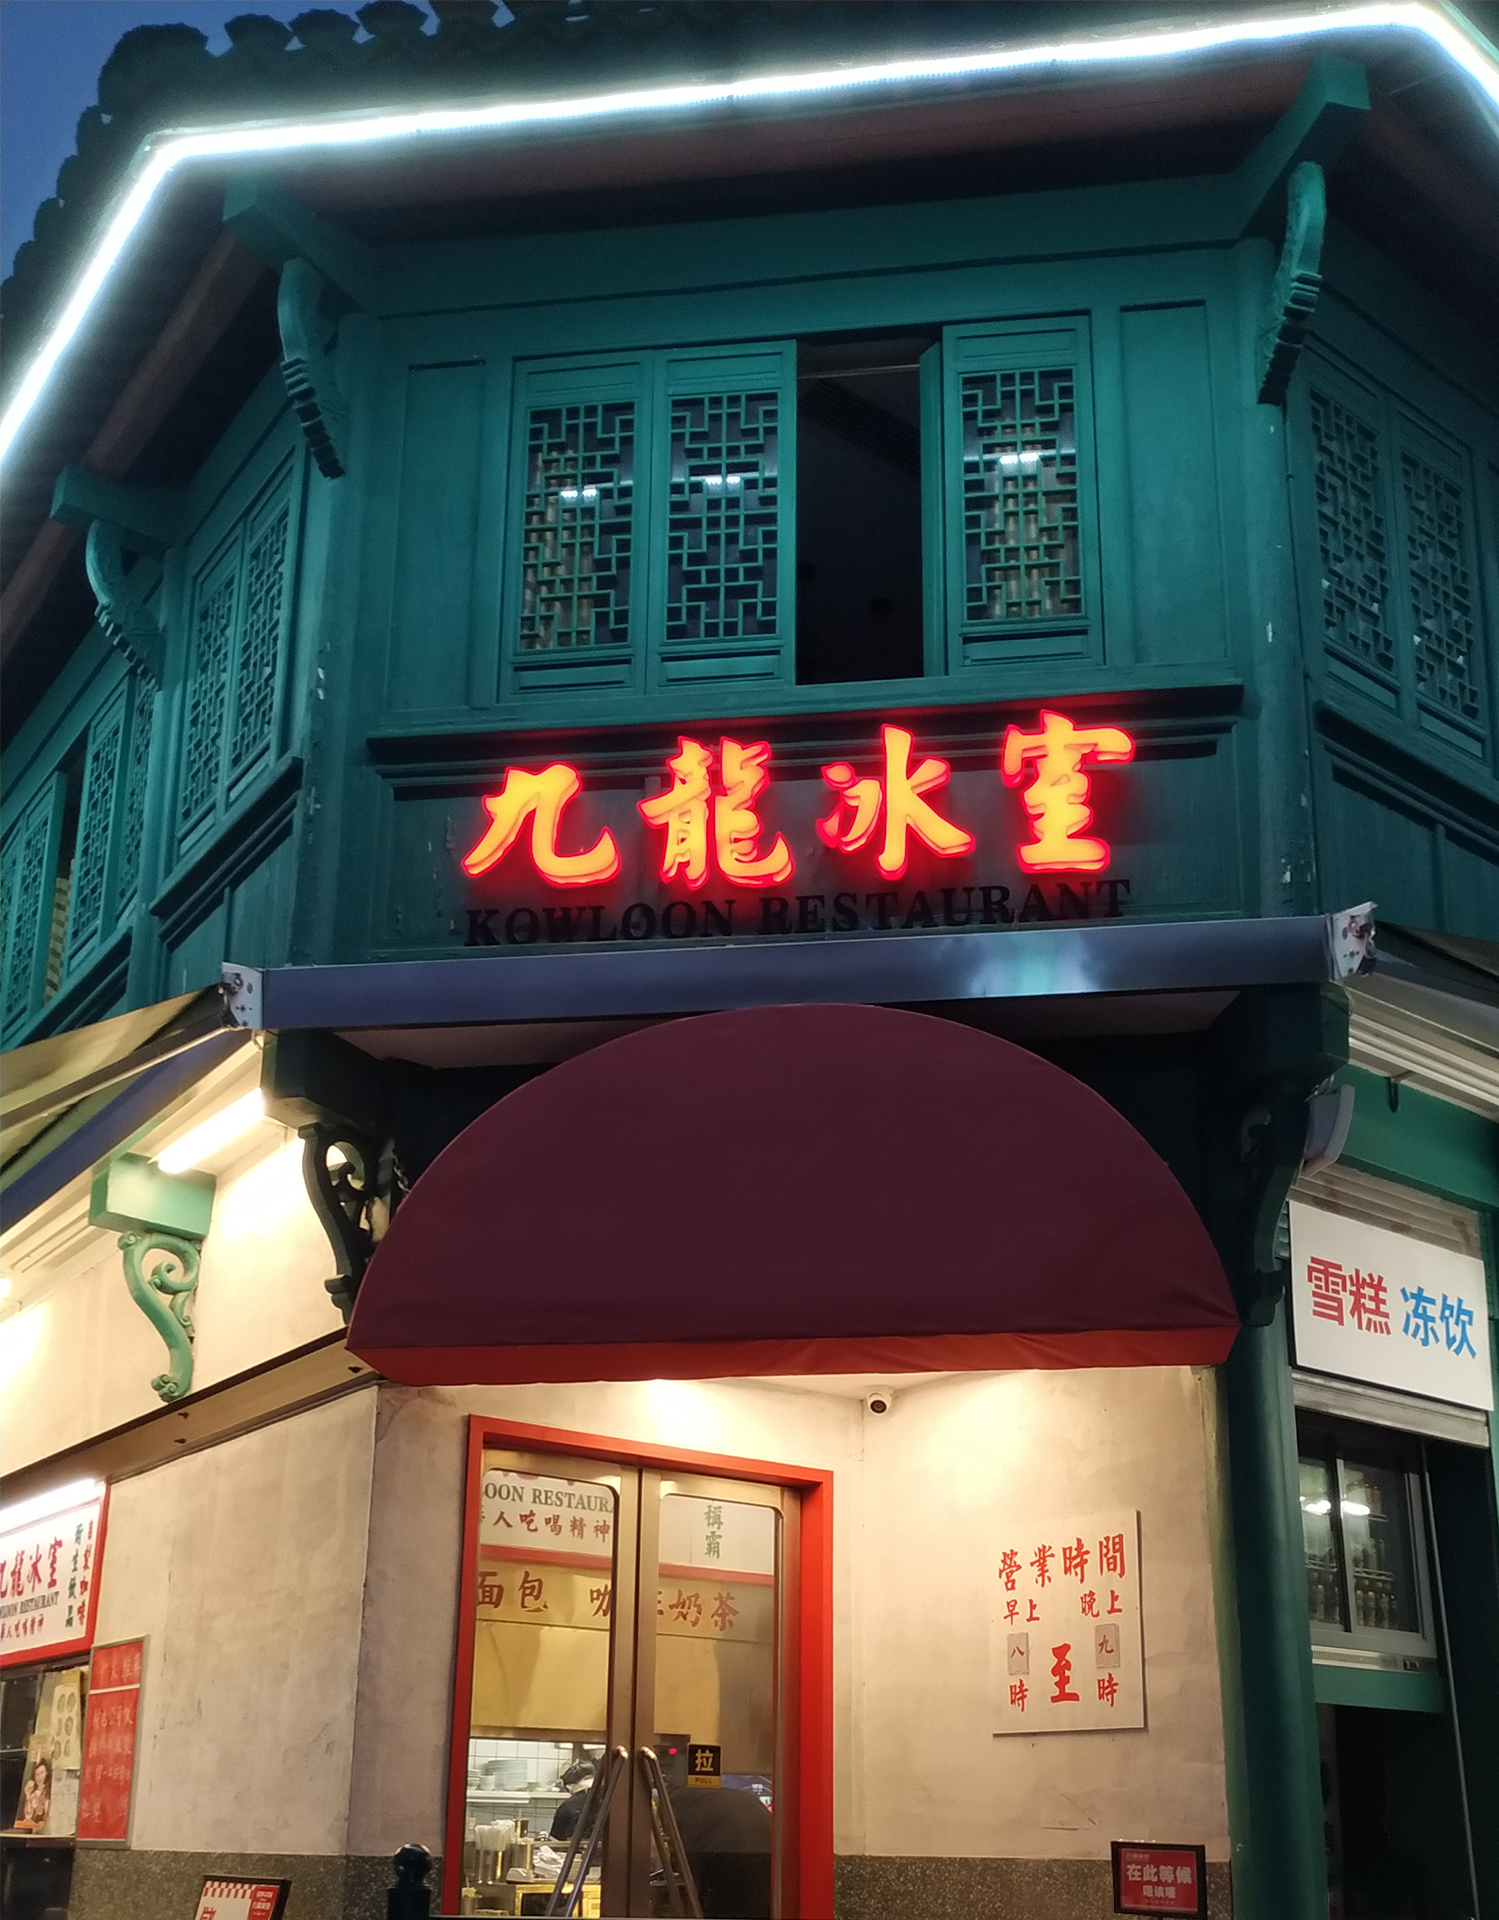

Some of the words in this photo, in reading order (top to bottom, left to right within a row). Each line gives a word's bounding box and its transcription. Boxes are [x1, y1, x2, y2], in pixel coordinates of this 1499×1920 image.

[462, 708, 1135, 890] 九龍冰室
[464, 899, 737, 947] KOWLOON
[758, 879, 1131, 936] RESTAURANT
[1306, 1255, 1391, 1336] 雪糕
[1400, 1285, 1477, 1359] 冻饮
[482, 1481, 525, 1502] OON
[703, 1504, 722, 1560] 稱霸
[998, 1532, 1127, 1592] 營業時間
[476, 1570, 548, 1614] 面包
[1003, 1598, 1040, 1626] 早上
[1080, 1589, 1123, 1618] 晚上
[1010, 1645, 1026, 1659] 八
[1098, 1634, 1115, 1655] 九
[1050, 1643, 1080, 1704] 至
[1097, 1672, 1119, 1708] 時
[1009, 1678, 1029, 1713] 時
[695, 1749, 714, 1772] 拉
